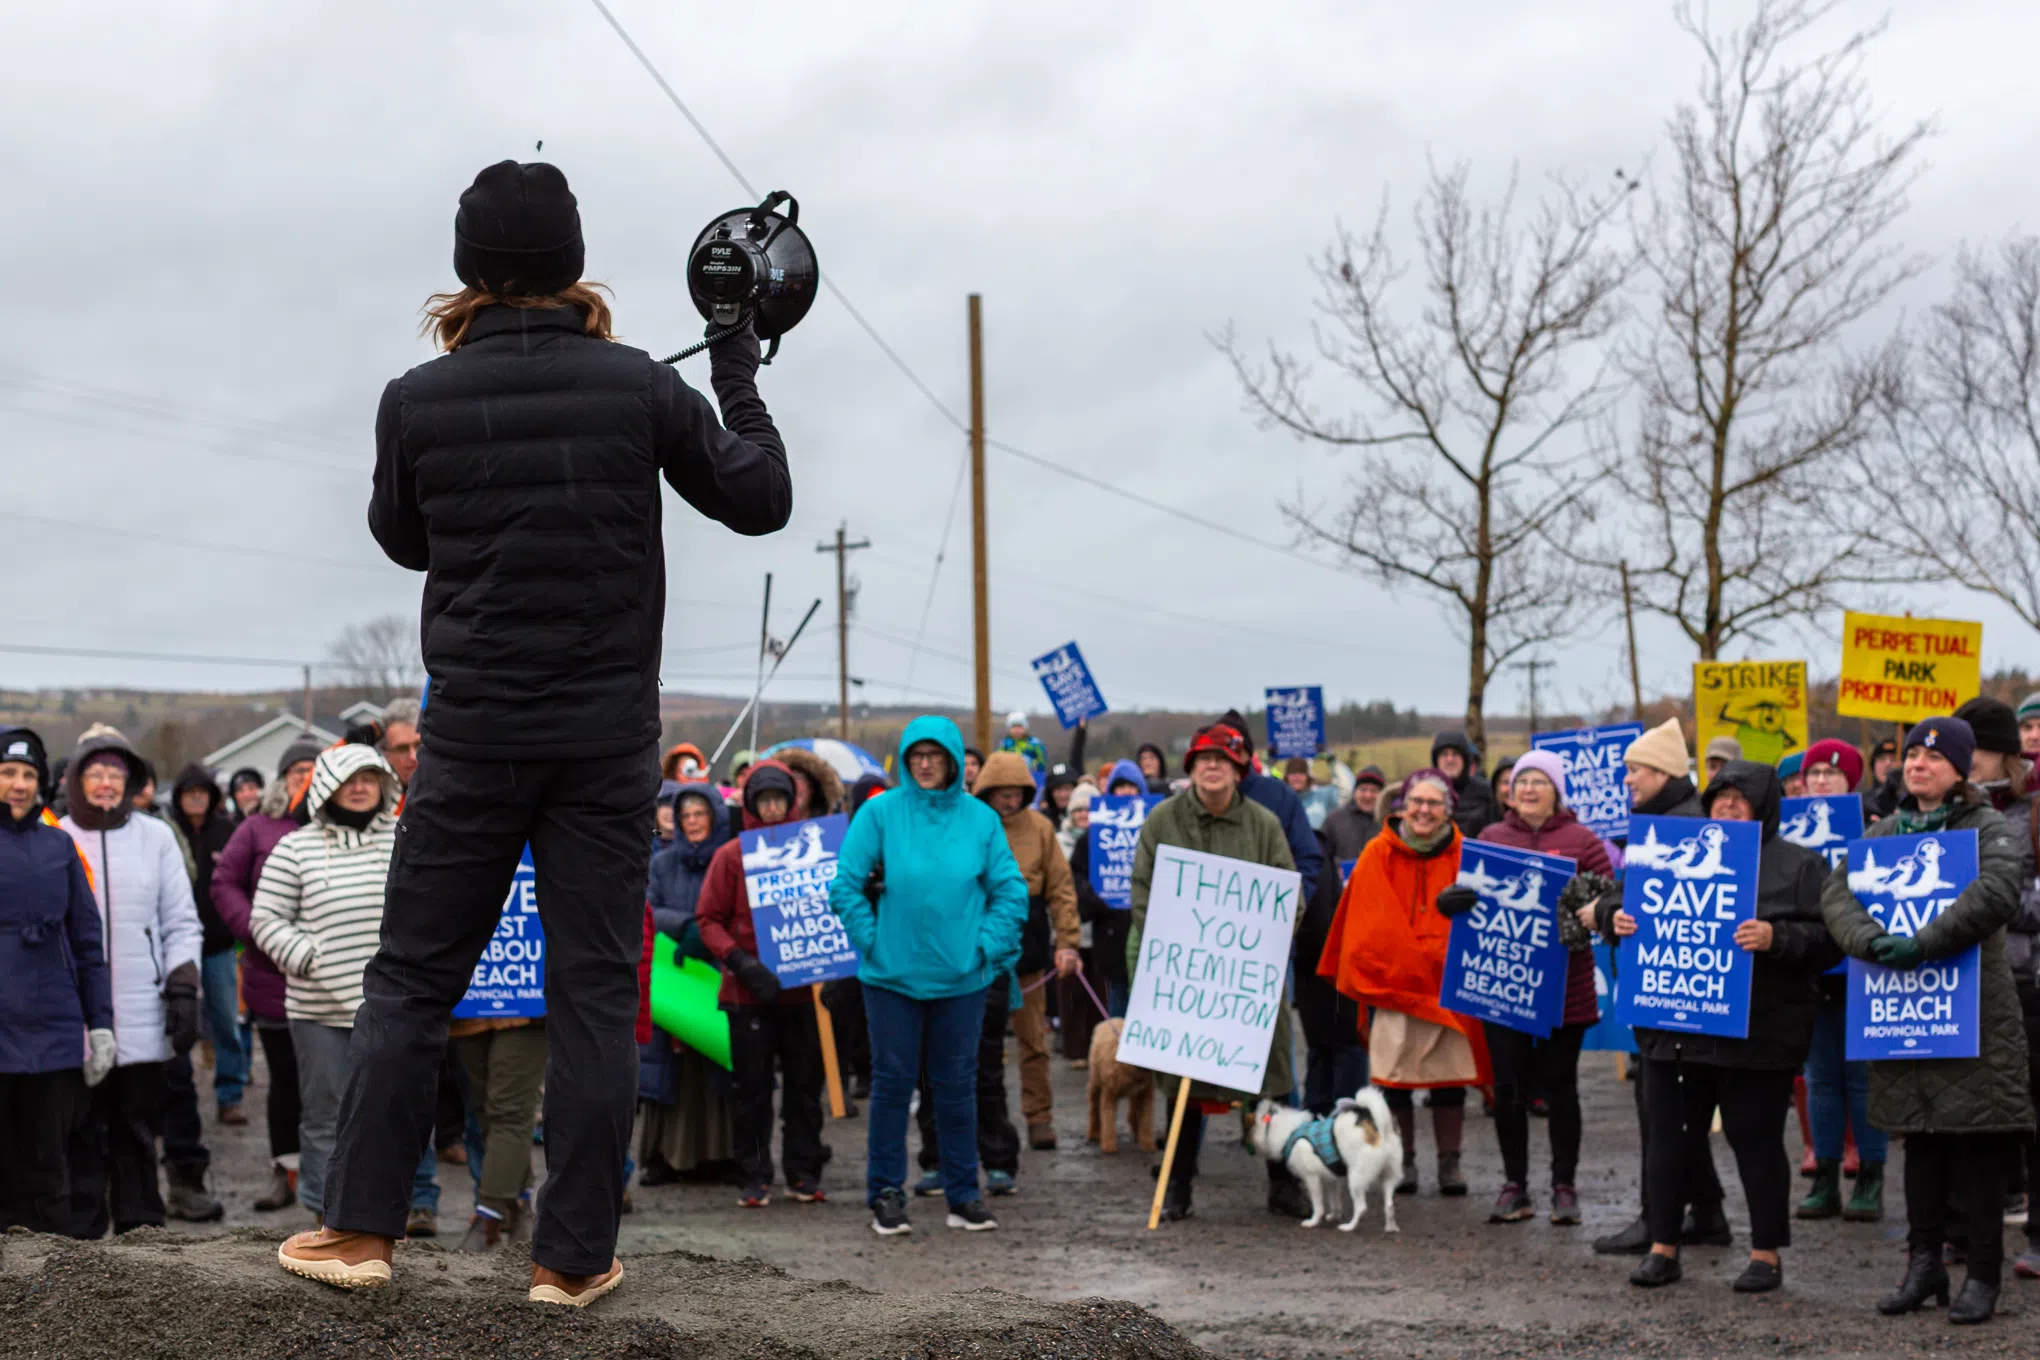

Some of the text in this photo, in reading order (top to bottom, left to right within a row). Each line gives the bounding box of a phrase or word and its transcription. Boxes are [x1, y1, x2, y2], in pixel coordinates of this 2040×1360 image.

[711, 247, 732, 255] PYLE
[1854, 627, 1975, 658] PERPETUAL
[1702, 663, 1800, 690] STRIKE
[1884, 658, 1937, 683] PARK
[1841, 678, 1957, 709] PROTECTION
[1272, 705, 1317, 722] SAVE
[1559, 743, 1622, 774] SAVE
[1568, 767, 1616, 788] WEST
[1577, 801, 1628, 824] EACH
[1099, 828, 1141, 850] SAV
[1106, 849, 1136, 863] WES
[757, 864, 836, 889] PROTEC
[1103, 877, 1132, 891] BEA
[1164, 856, 1293, 923] THANK
[1640, 878, 1738, 920] SAVE
[1192, 908, 1262, 951] YOU
[1467, 901, 1552, 949] SAVE
[1653, 917, 1722, 946] WEST
[779, 931, 849, 962] BEACH
[1477, 932, 1535, 964] WEST
[1637, 942, 1734, 974] MABOU
[470, 964, 537, 987] EACH
[1146, 938, 1280, 999] PREMIER
[1461, 950, 1544, 988] MABOU
[1865, 967, 1959, 996] MABOU
[1463, 971, 1535, 1007] BEACH
[1642, 969, 1725, 1000] BEACH
[1153, 977, 1280, 1029] HOUSTON
[1456, 988, 1511, 1014] PROVINCIAL
[1512, 1006, 1538, 1020] PARK
[1633, 994, 1730, 1015] PROVINCIAL PARK
[1870, 996, 1952, 1023] BEACH
[1125, 1020, 1244, 1067] AND NOW
[1863, 1023, 1959, 1039] PROVINCIAL PARK
